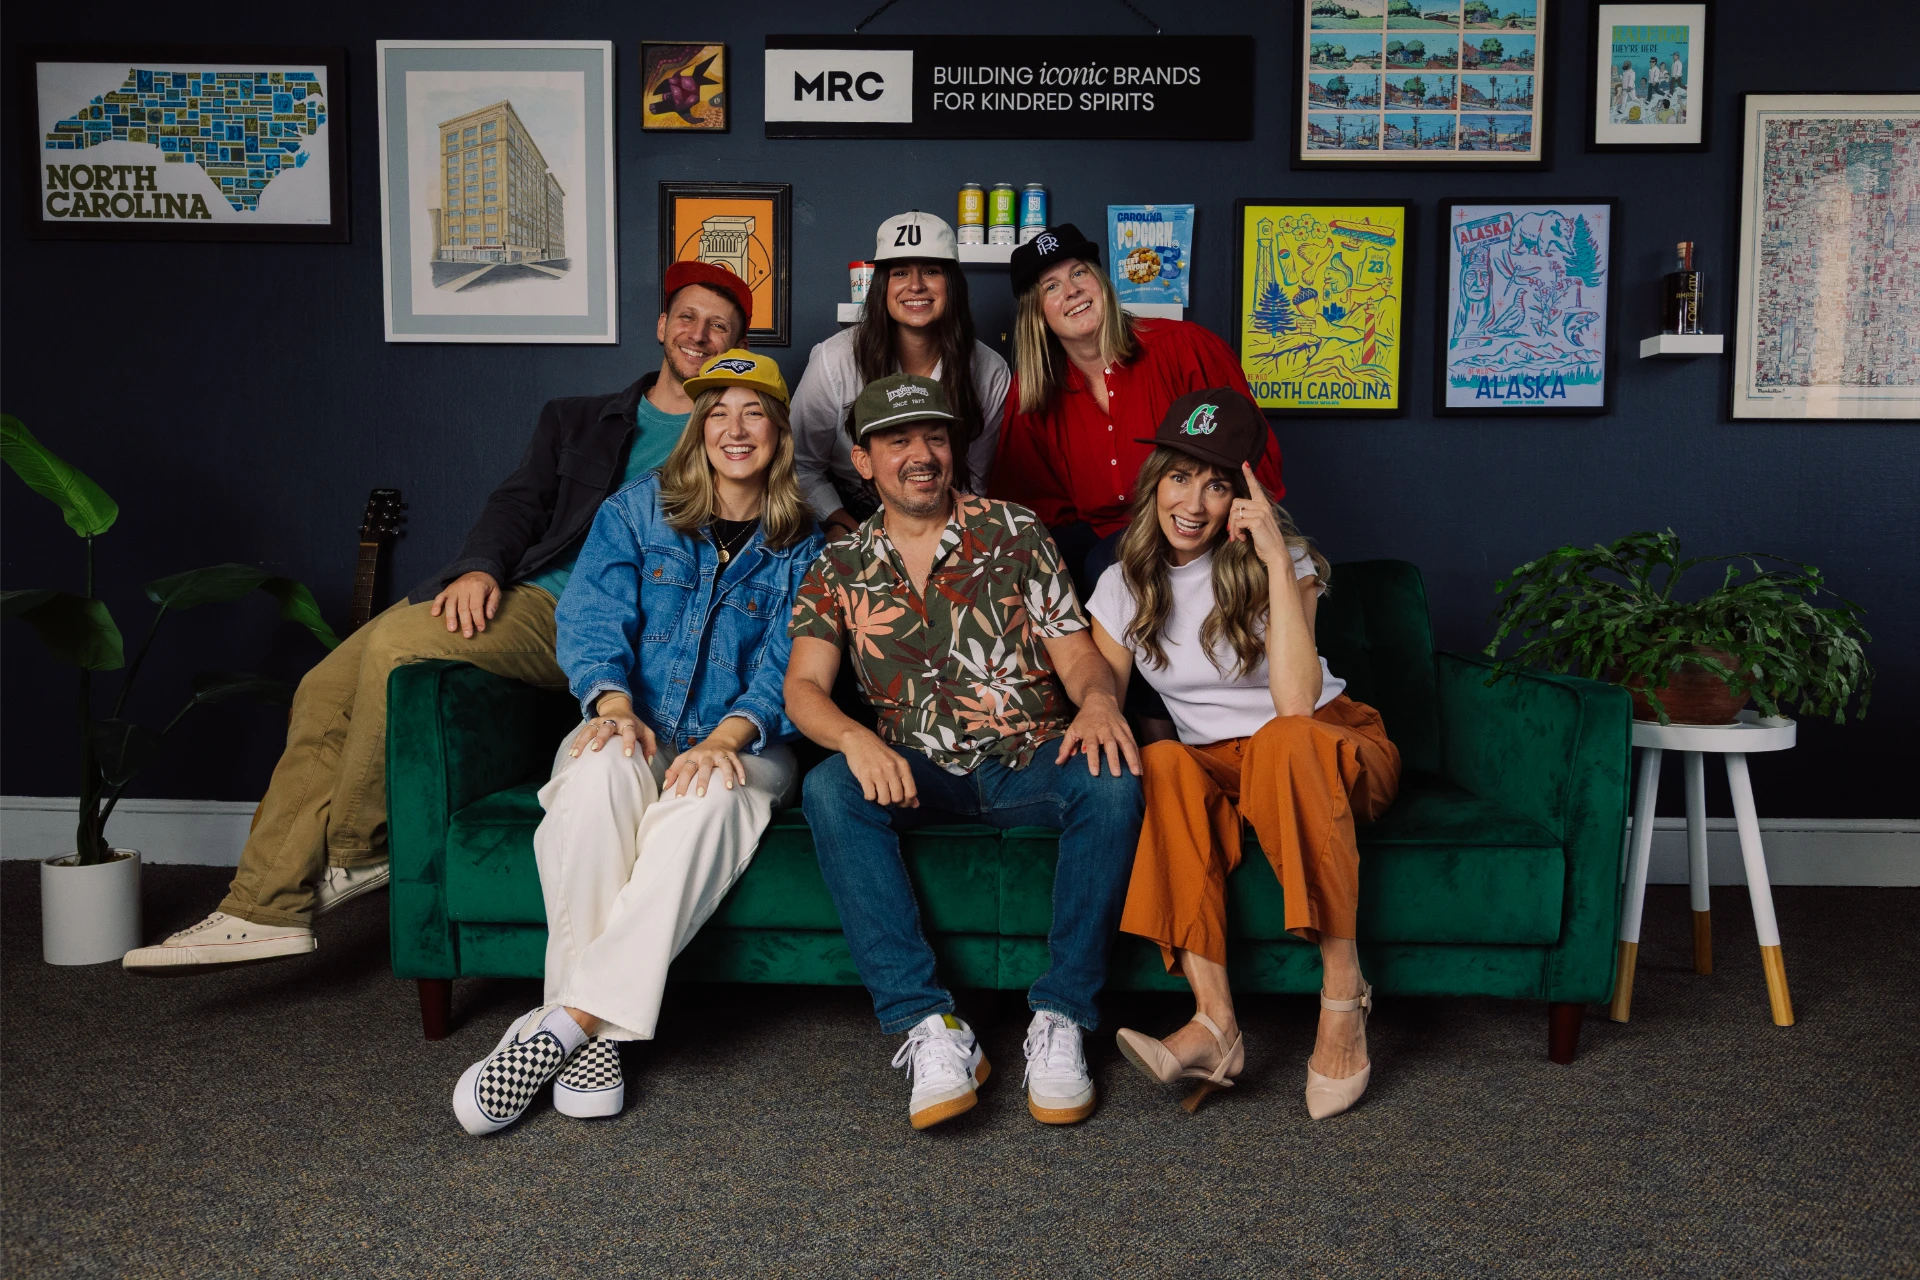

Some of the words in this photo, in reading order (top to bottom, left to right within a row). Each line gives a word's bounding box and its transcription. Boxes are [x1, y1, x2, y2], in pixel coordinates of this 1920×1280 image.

[1612, 26, 1688, 43] RALEIGH
[1612, 44, 1638, 53] THEY'RE
[1641, 44, 1658, 53] HERE
[933, 66, 1034, 85] BUILDING
[1039, 61, 1109, 86] iconic
[1113, 67, 1201, 85] BRANDS
[794, 70, 885, 102] MRC
[933, 92, 974, 110] FOR
[981, 93, 1073, 111] KINDRED
[1080, 93, 1155, 111] SPIRITS
[46, 164, 157, 191] NORTH
[46, 192, 212, 219] CAROLINA
[1117, 213, 1163, 222] CAROLINA
[894, 225, 922, 247] ZU
[1117, 222, 1174, 250] POPCORN
[1460, 220, 1512, 245] ALASKA
[1118, 258, 1139, 266] SWEET
[1124, 264, 1149, 272] SAVORY
[1368, 261, 1384, 273] 23
[1688, 300, 1697, 322] OAK
[1247, 373, 1254, 381] BE
[1255, 373, 1268, 381] WILD
[1467, 368, 1474, 376] BE
[1475, 368, 1489, 376] WILD
[1249, 382, 1302, 399] NORTH
[1307, 382, 1392, 399] CAROLINA
[1475, 376, 1566, 399] ALASKA
[893, 400, 908, 409] SINCE
